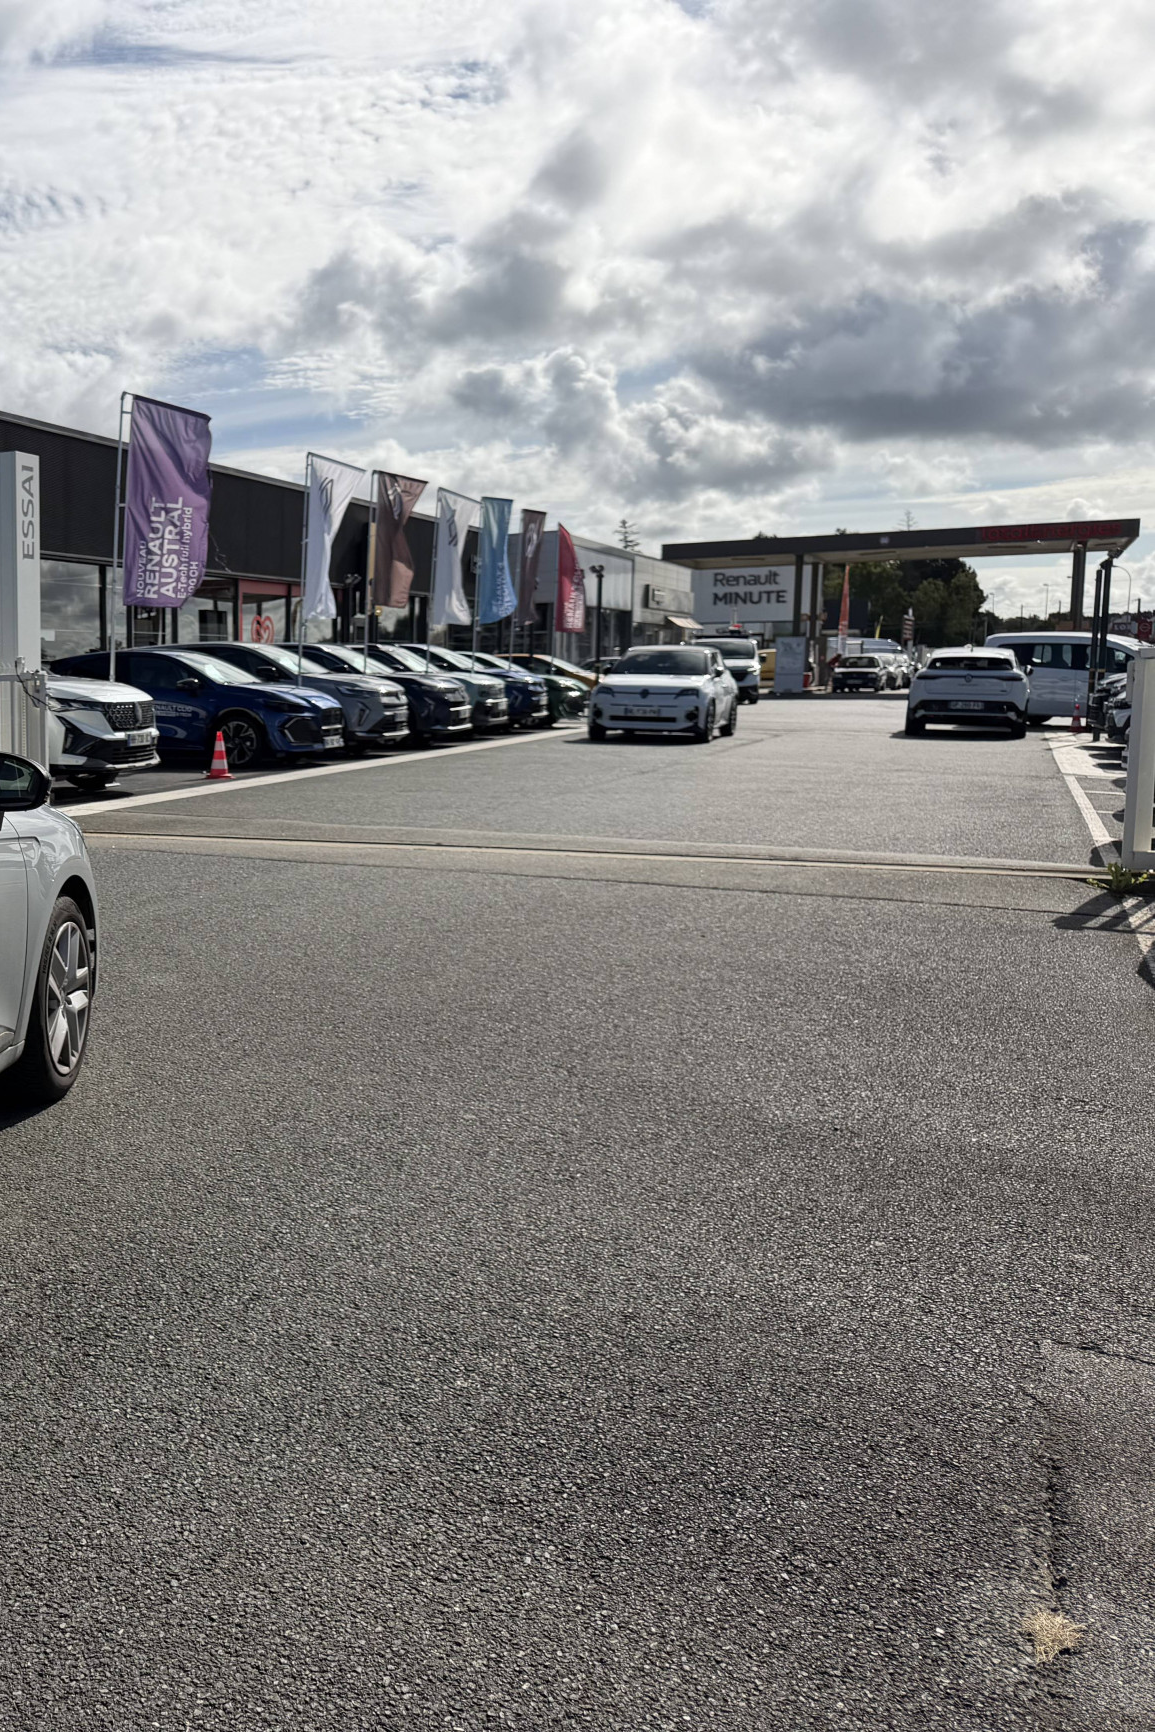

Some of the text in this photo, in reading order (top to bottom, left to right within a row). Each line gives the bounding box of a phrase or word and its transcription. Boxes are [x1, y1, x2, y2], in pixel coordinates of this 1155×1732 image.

[21, 465, 35, 560] ESSAI
[181, 507, 193, 543] hybrid
[144, 496, 166, 599] RENAULT
[160, 496, 183, 598] AUSTRAL
[136, 541, 147, 597] NOUVEAU
[177, 563, 189, 599] E-Tech
[713, 570, 780, 587] Renault
[712, 590, 788, 606] MINUTE
[155, 704, 177, 712] NAULT
